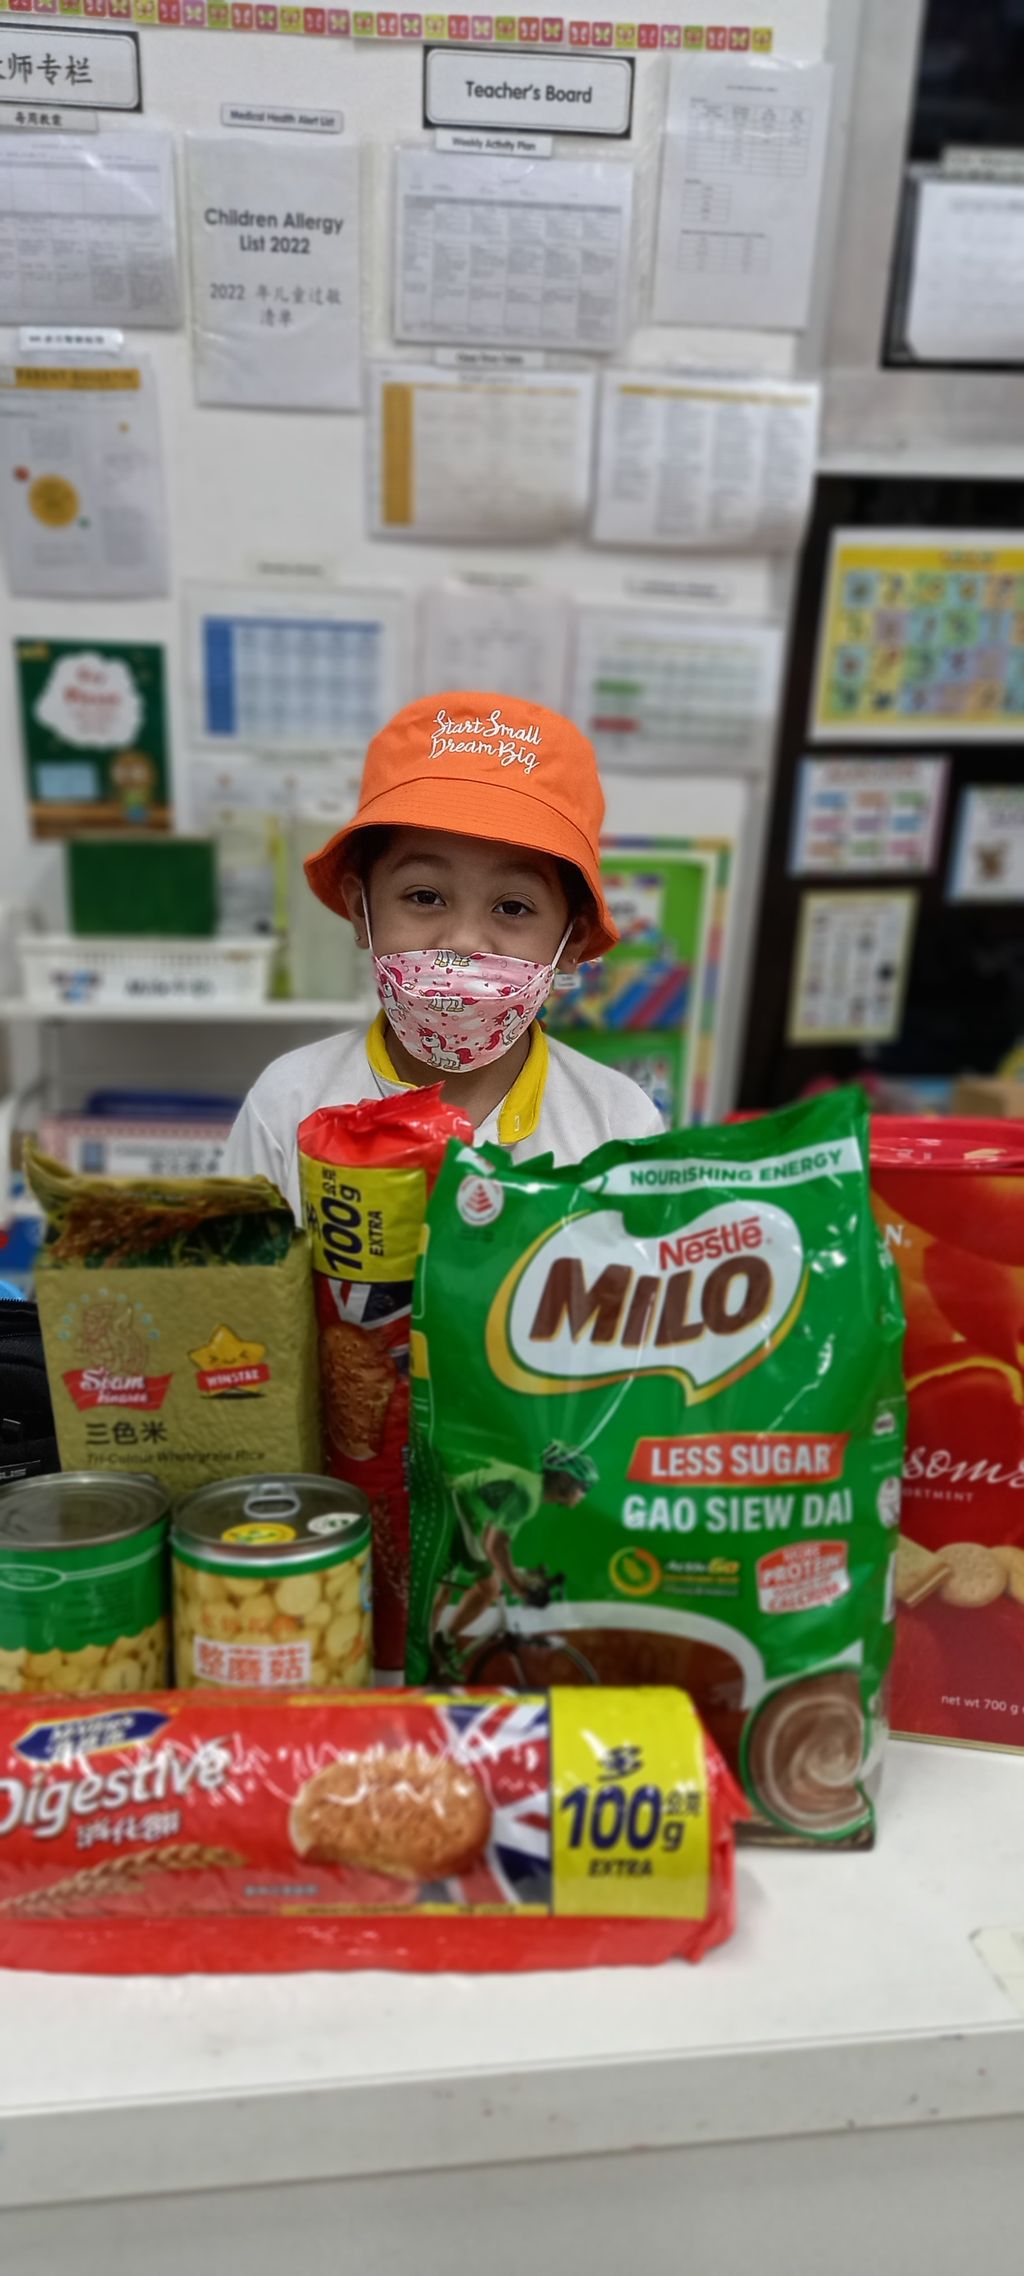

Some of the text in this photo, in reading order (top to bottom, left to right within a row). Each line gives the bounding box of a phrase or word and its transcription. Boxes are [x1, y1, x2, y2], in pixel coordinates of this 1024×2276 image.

[466, 80, 592, 103] Teacher's Board
[230, 110, 265, 122] Medical
[267, 112, 296, 124] Health
[320, 117, 335, 127] List
[453, 137, 536, 152] Weekly Activity Plan
[204, 208, 344, 235] Children Allergy
[239, 235, 310, 254] List 2022
[210, 283, 342, 306] 2022 年儿童过敏
[431, 709, 542, 745] Start Small
[428, 738, 540, 774] Dream Big
[630, 1148, 842, 1187] NOURISHING ENERGY
[367, 1210, 384, 1257] EXTRA
[528, 1255, 774, 1349] MILO
[80, 1367, 145, 1391] Siam
[206, 1368, 260, 1388] WINSTAR
[85, 1420, 168, 1446] 三色米
[236, 1450, 266, 1462] Rice
[651, 1443, 831, 1478] LESS SUGAR
[902, 1487, 974, 1503] ORTMENT
[622, 1488, 853, 1533] GAO SIEW DAI
[941, 1695, 1019, 1715] net wt 700 g
[0, 1744, 230, 1838] Digestive
[588, 1858, 653, 1878] EXTRA
